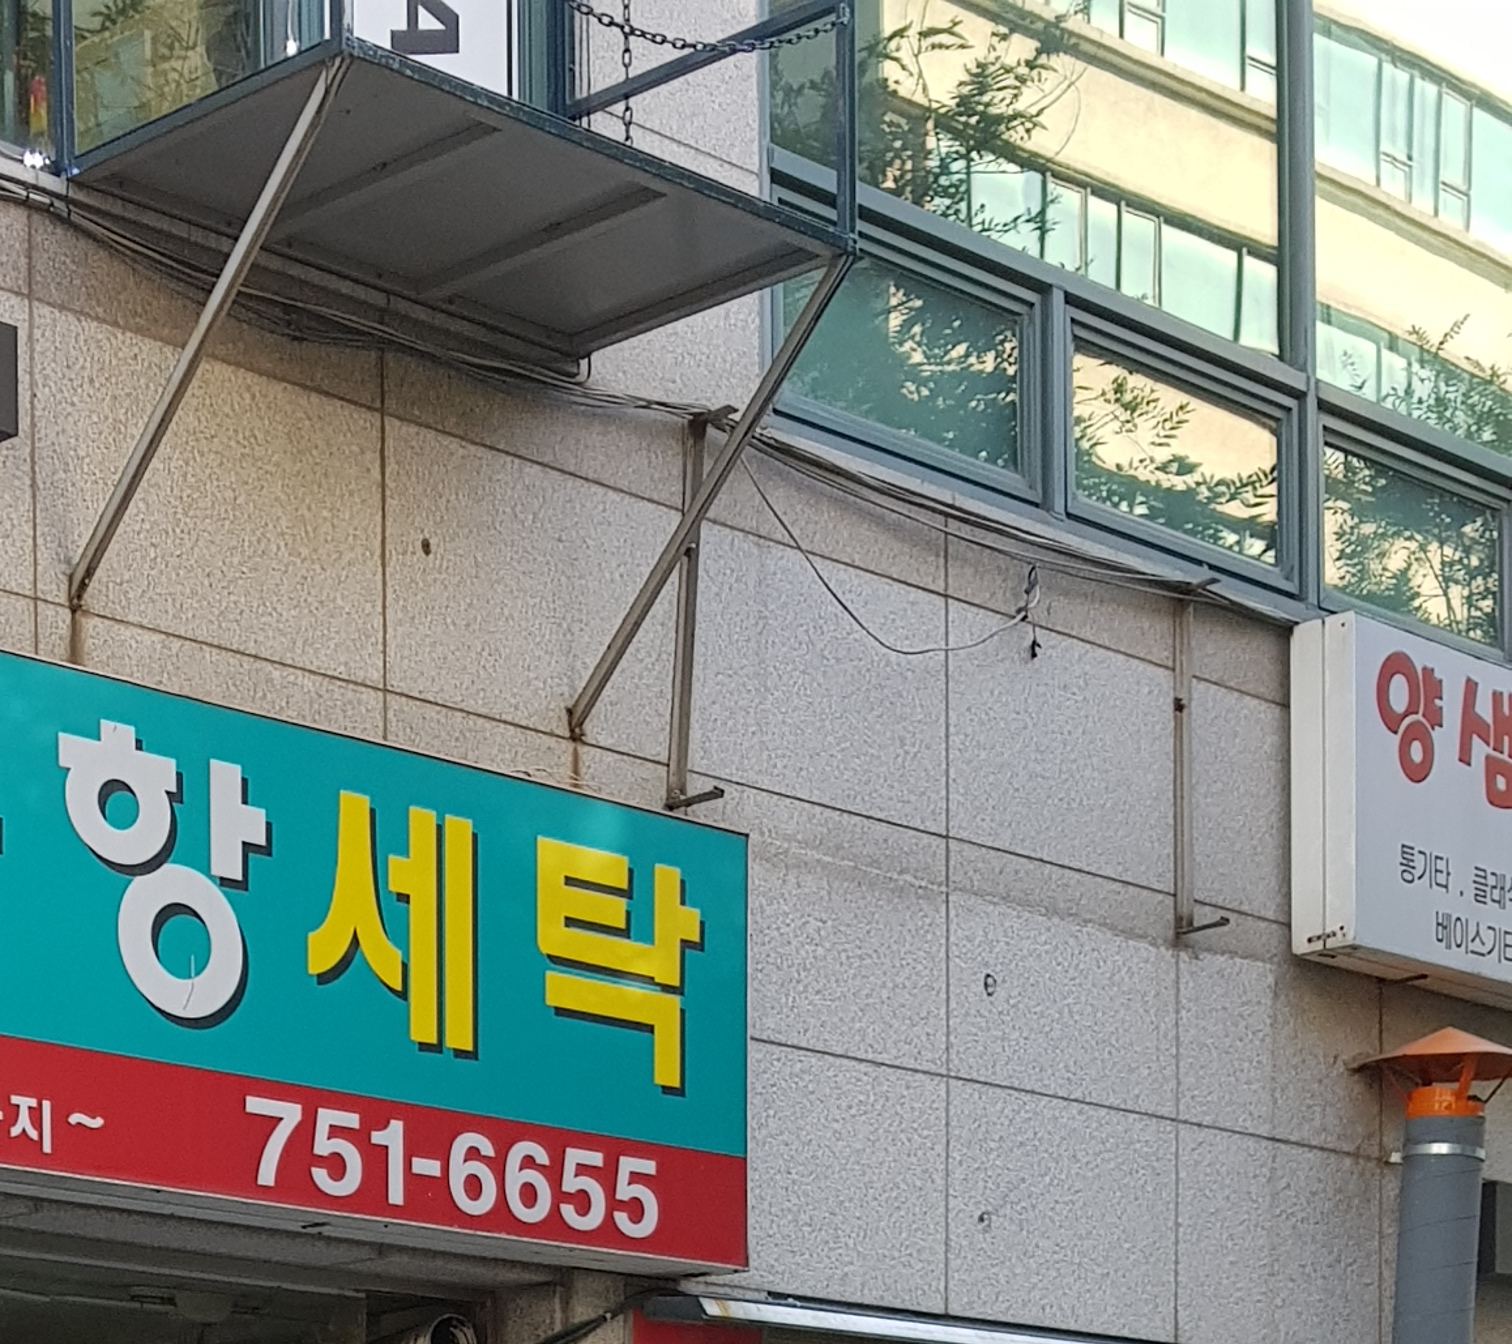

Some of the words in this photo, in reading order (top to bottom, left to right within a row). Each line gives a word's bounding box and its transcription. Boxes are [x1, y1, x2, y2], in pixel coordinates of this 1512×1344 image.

[1399, 843, 1451, 894] 통기타
[1472, 866, 1512, 910] 클래
[245, 1095, 658, 1239] 751-6655
